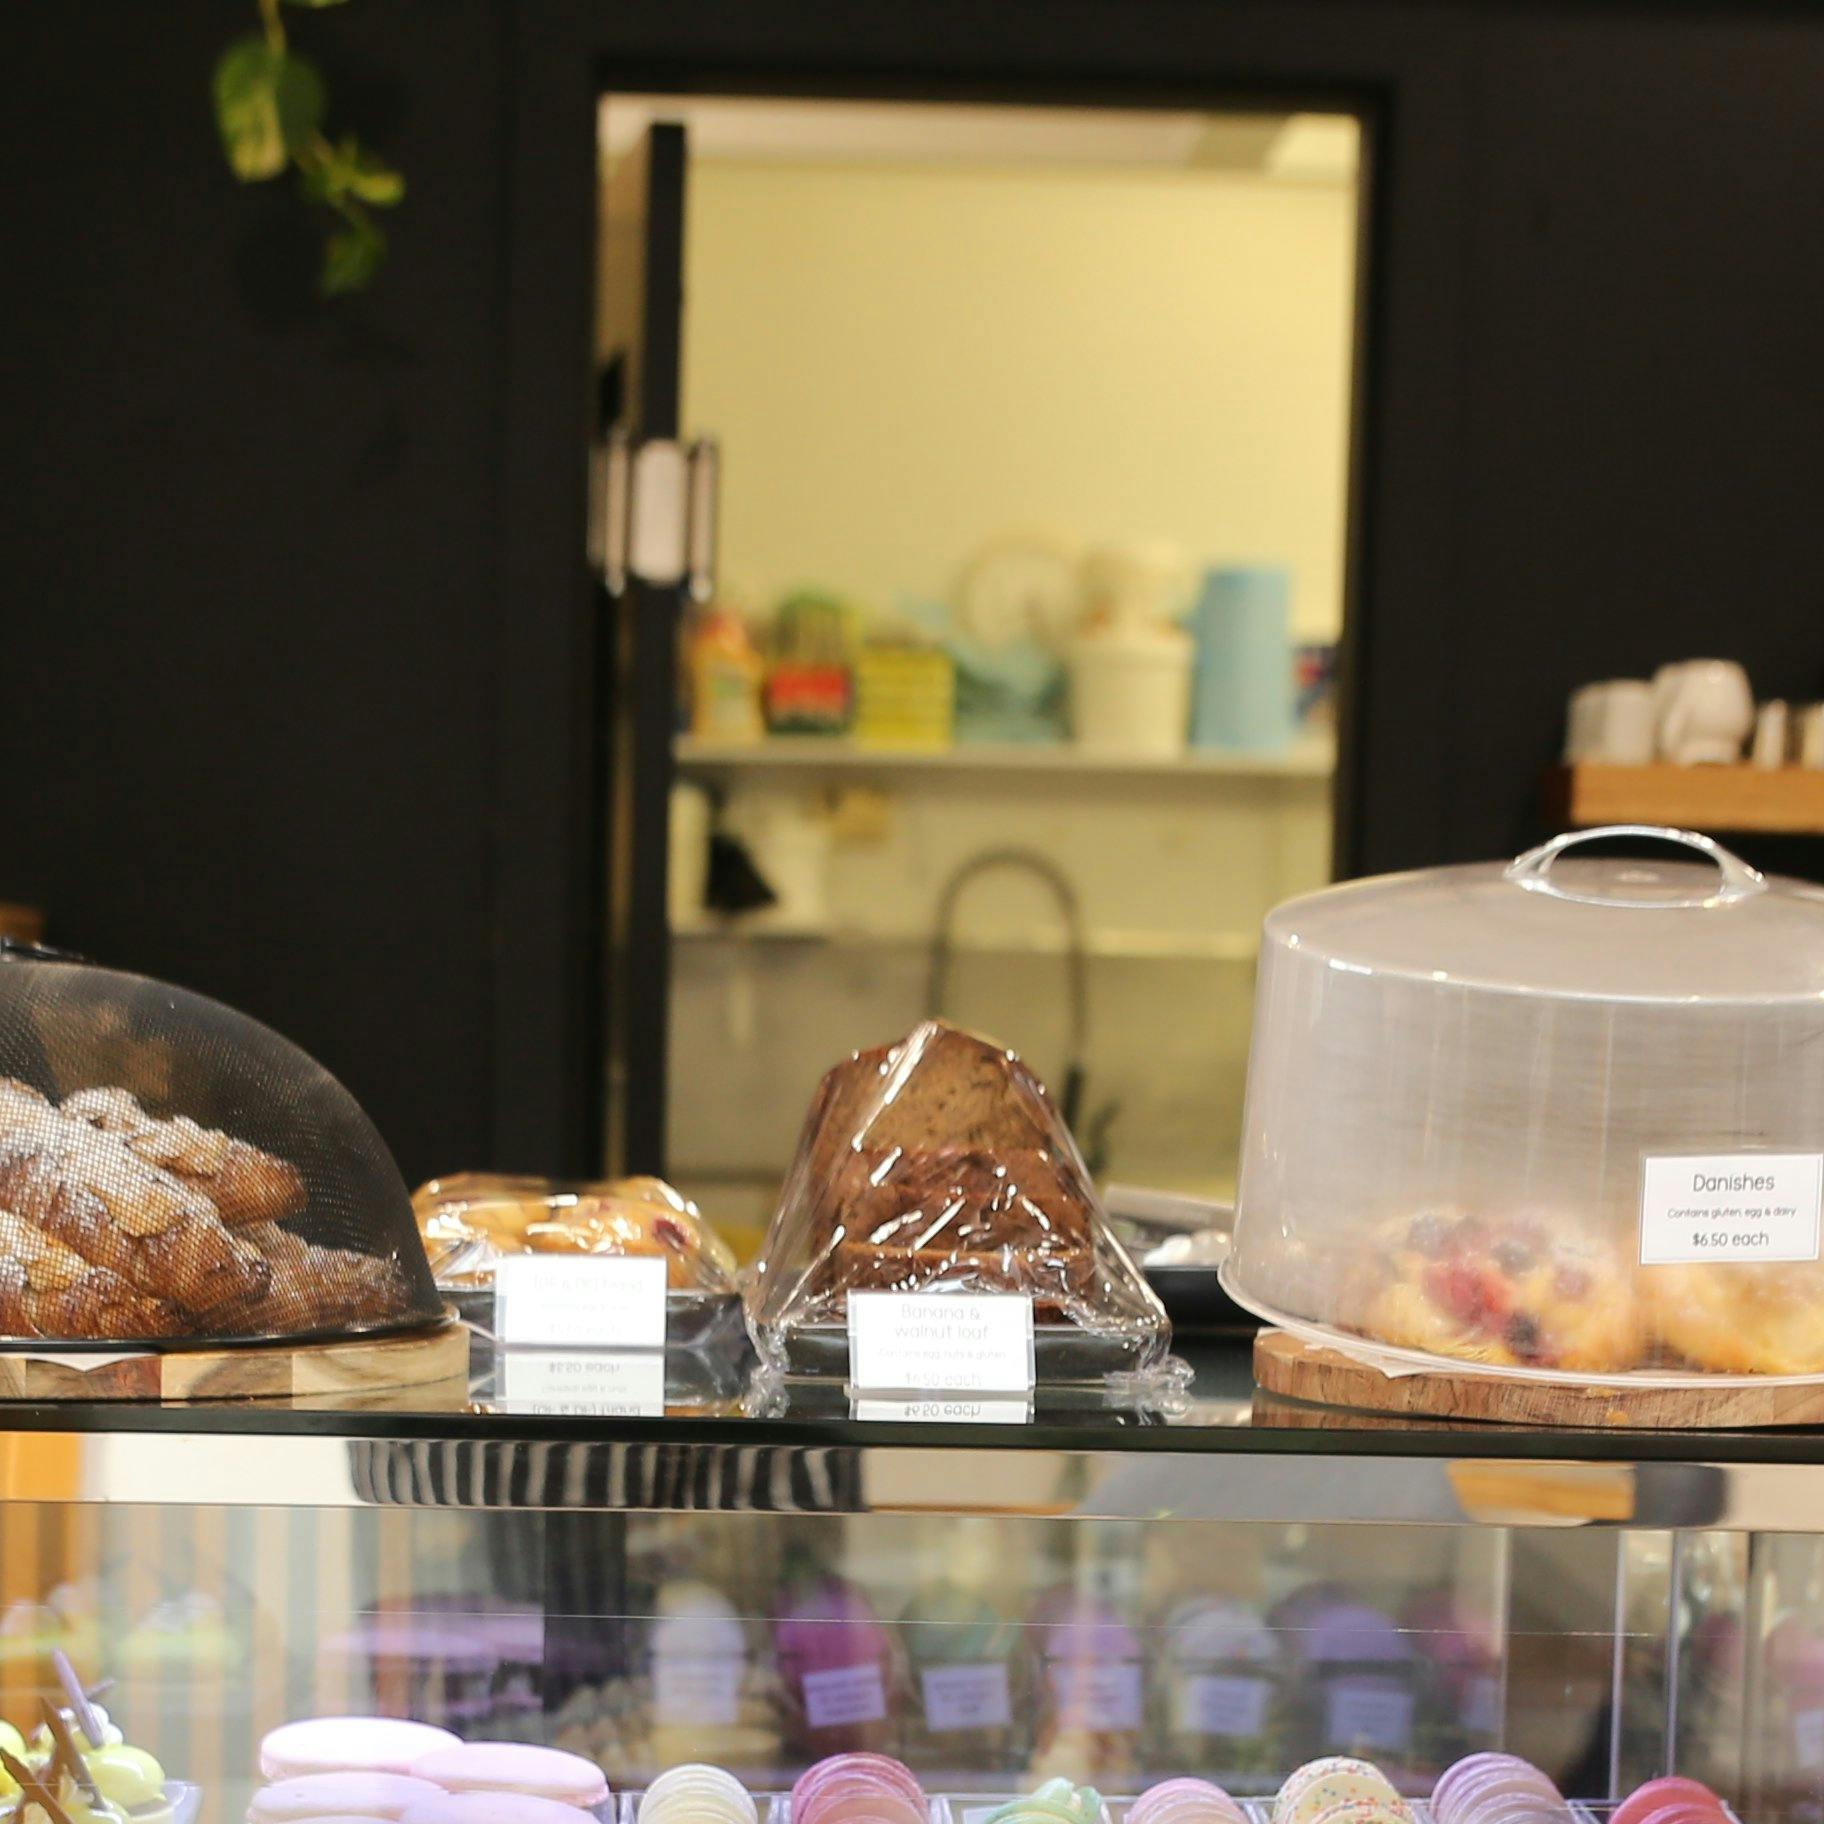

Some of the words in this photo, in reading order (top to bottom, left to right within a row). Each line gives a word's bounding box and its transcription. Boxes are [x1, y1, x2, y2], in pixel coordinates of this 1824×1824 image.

[1693, 1173, 1776, 1193] Danishes
[1692, 1232, 1729, 1248] $6.50
[1732, 1231, 1770, 1248] each
[902, 1304, 964, 1321] Banana
[970, 1307, 982, 1320] &
[895, 1325, 952, 1340] walnut
